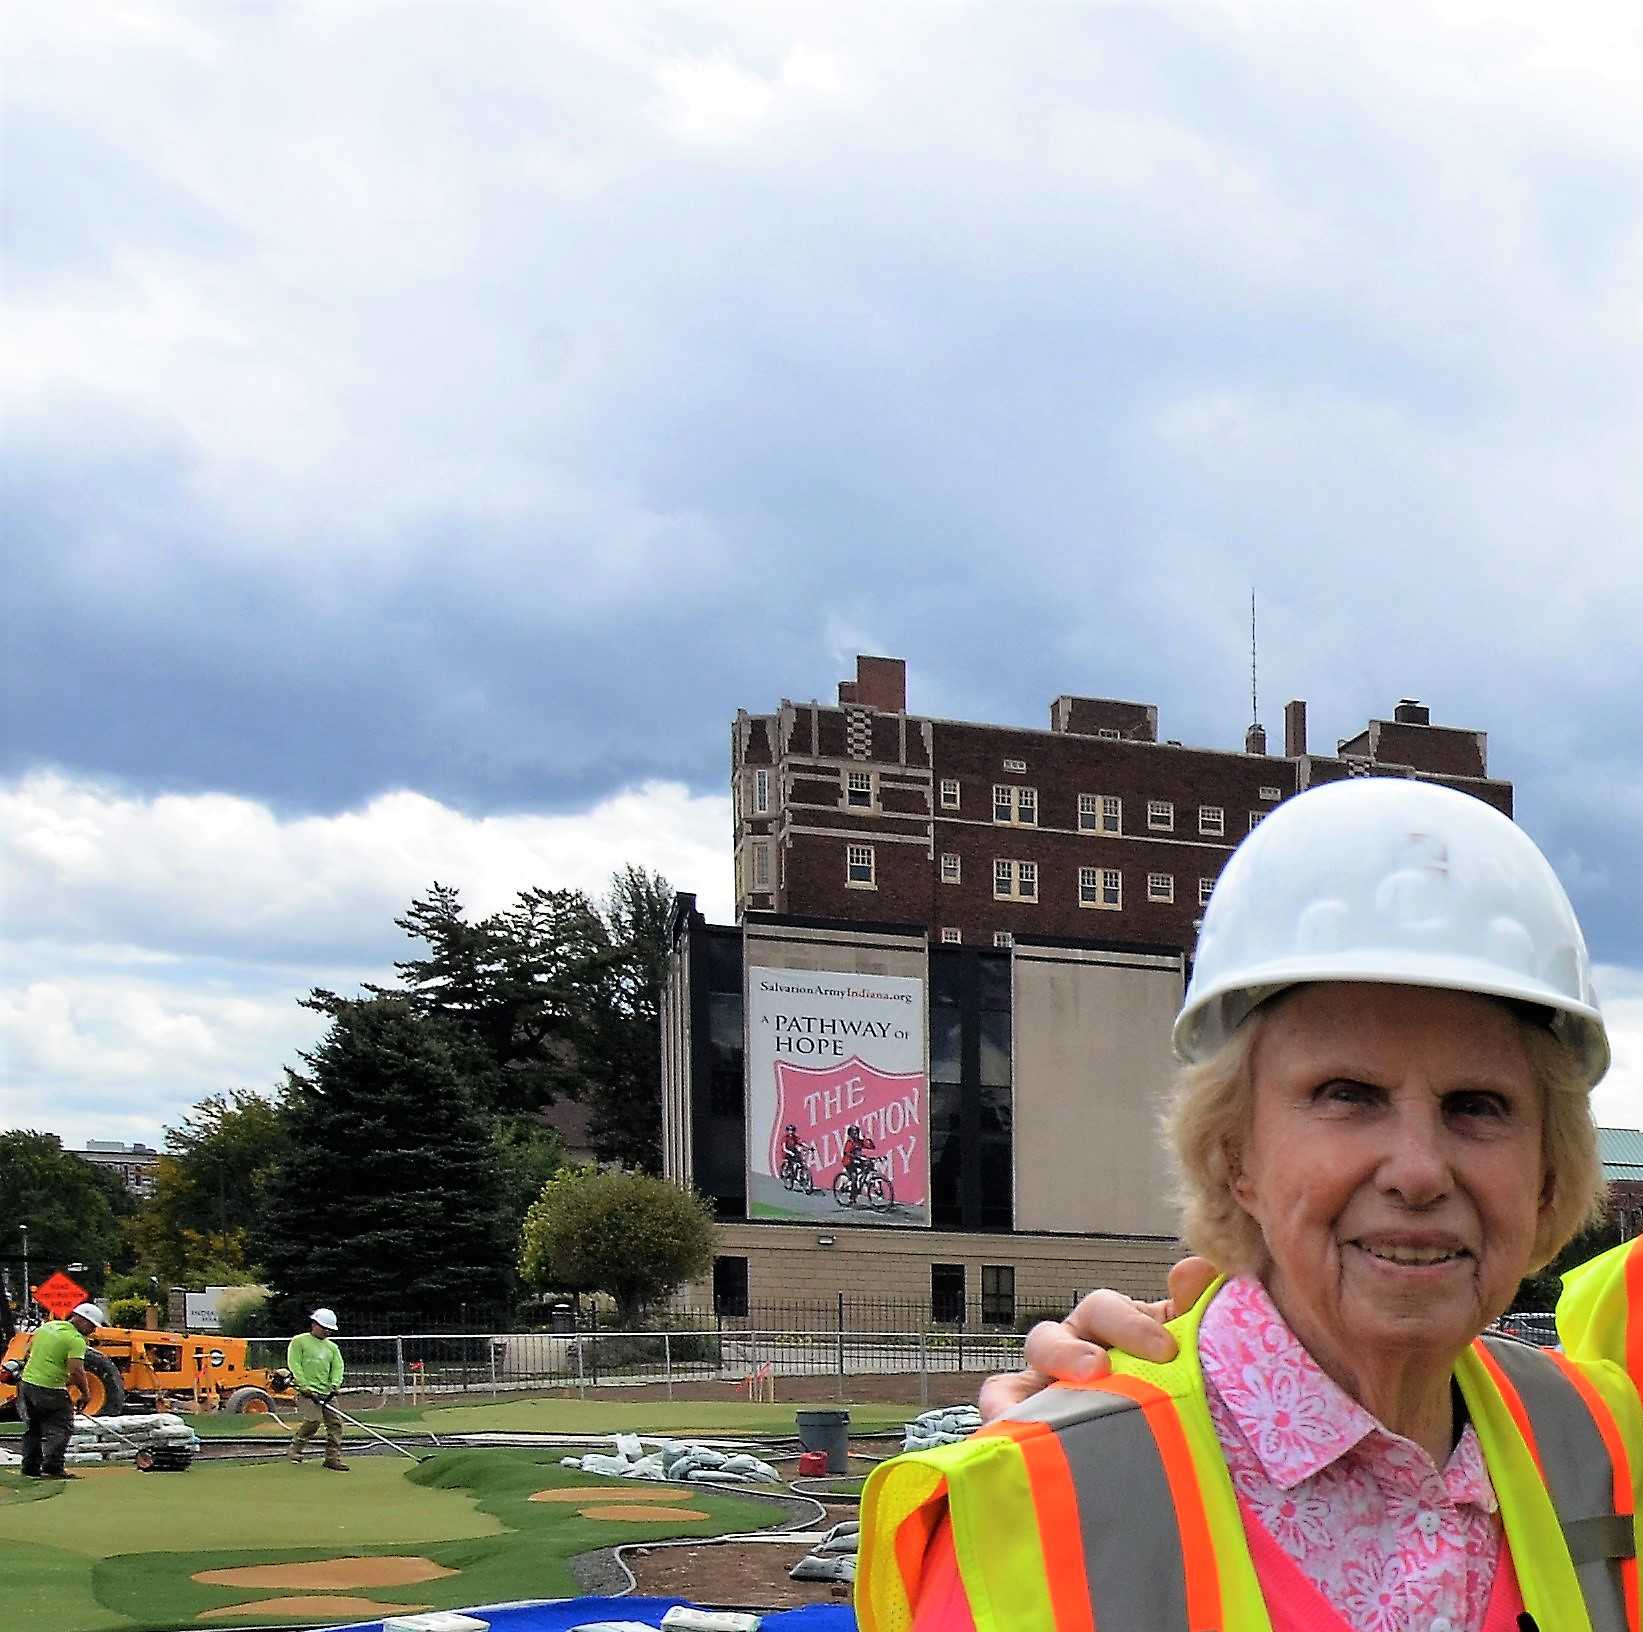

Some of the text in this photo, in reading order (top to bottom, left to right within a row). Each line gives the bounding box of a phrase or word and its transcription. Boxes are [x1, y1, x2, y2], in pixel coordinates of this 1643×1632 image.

[760, 981, 912, 1003] SalvationArmyIndiana.org
[775, 1015, 892, 1040] PATHWAY
[776, 1036, 844, 1056] HOPE
[804, 1076, 865, 1127] THE
